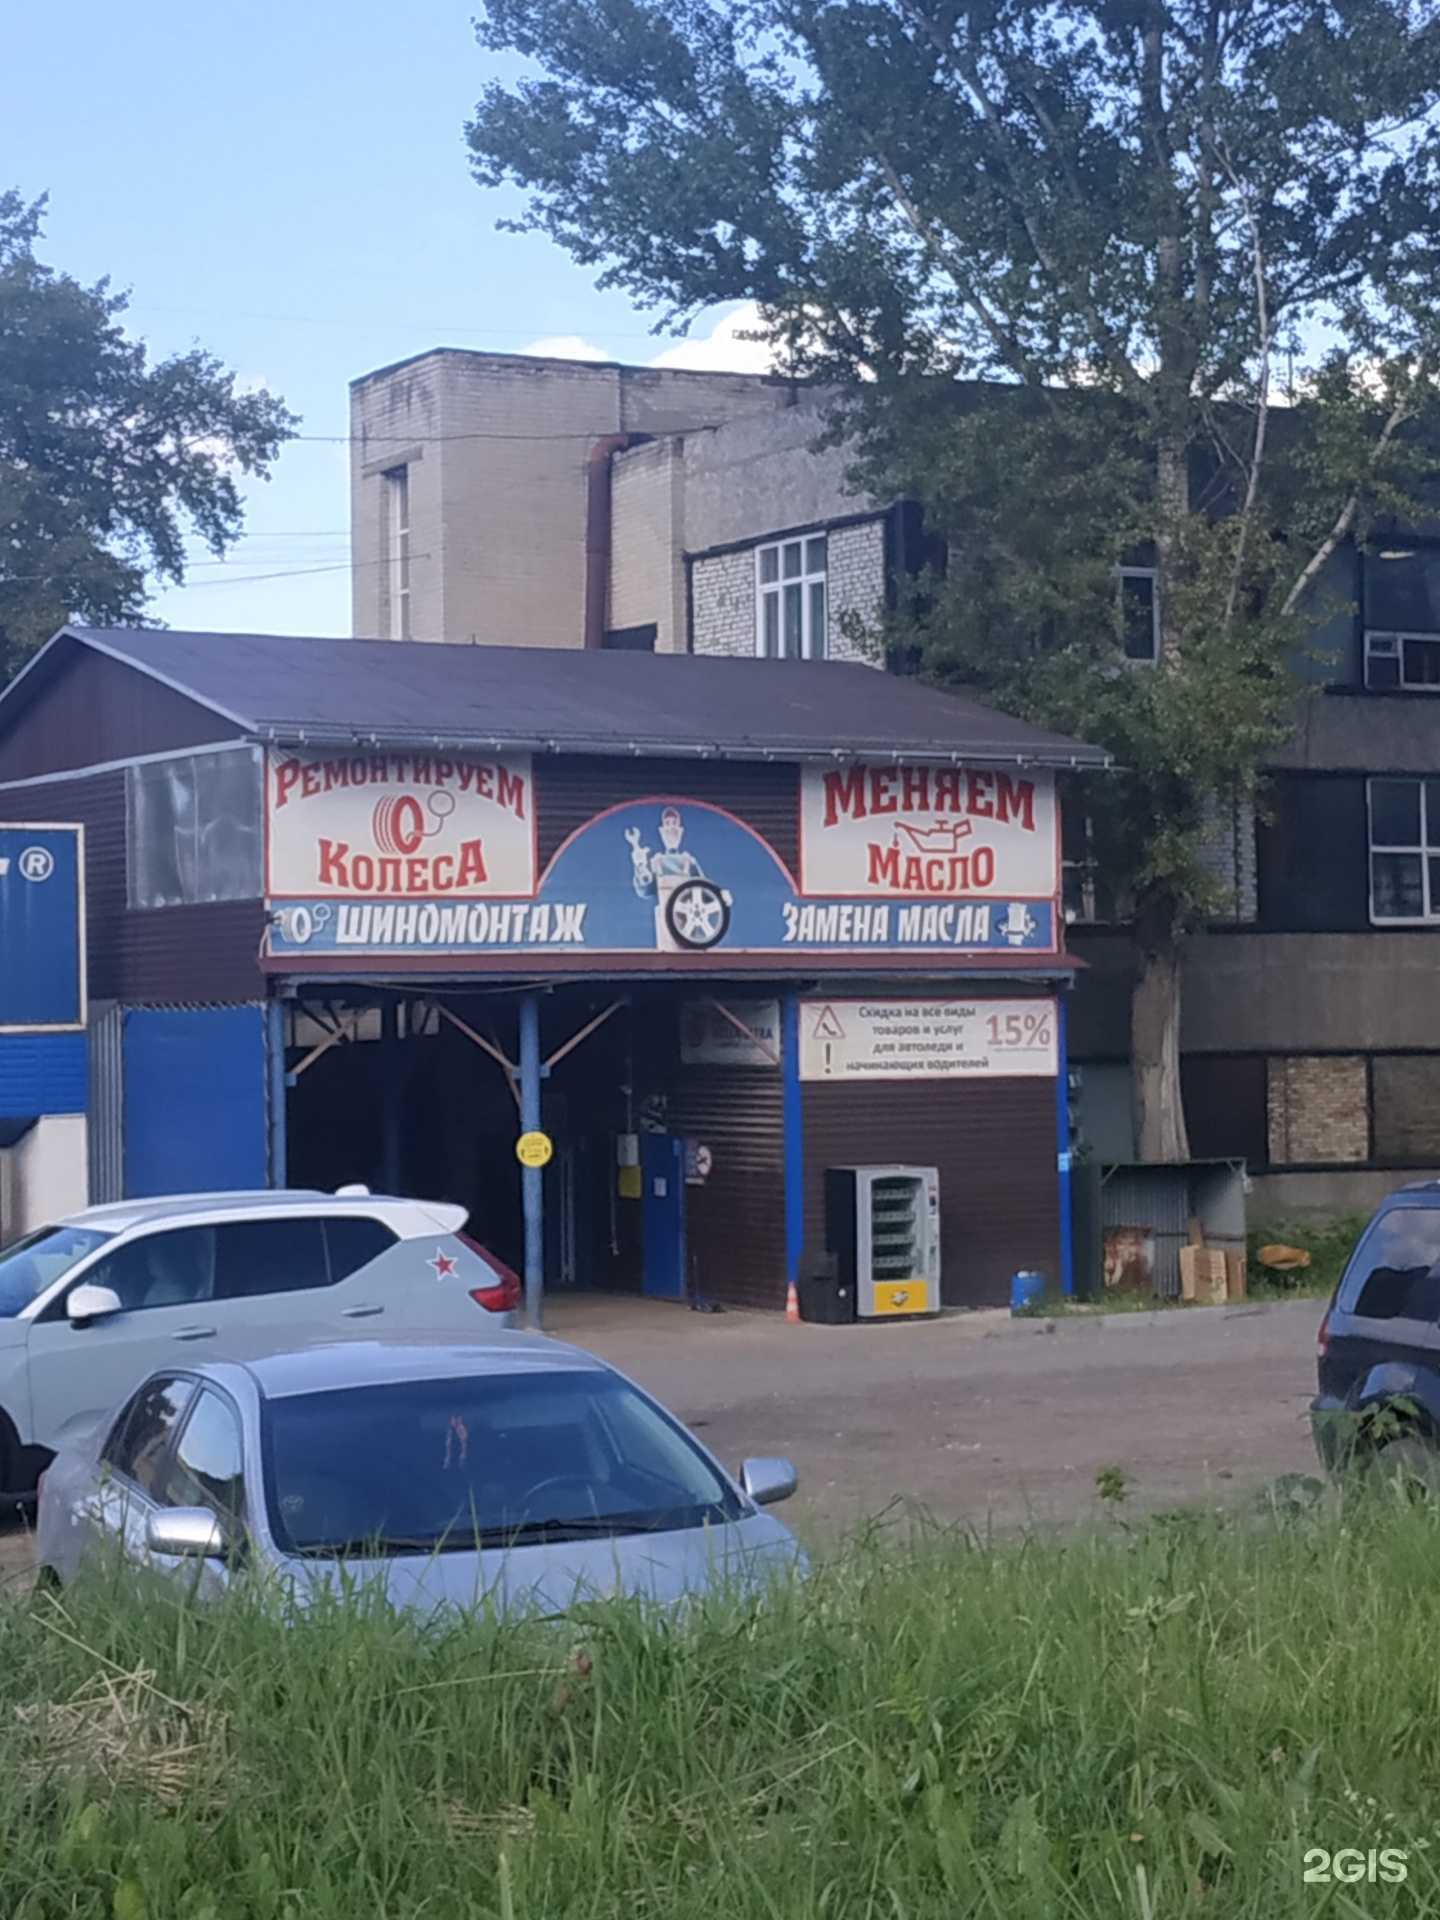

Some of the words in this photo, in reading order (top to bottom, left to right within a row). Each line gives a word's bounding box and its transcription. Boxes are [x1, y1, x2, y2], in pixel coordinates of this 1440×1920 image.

[275, 752, 525, 820] РЕМОНТИРУЕМ
[823, 764, 1036, 832] МЕНЯЕМ
[318, 838, 488, 893] КОЛЕСА
[867, 843, 995, 892] МАСЛО
[335, 903, 589, 945] ШИНОМОНТАЖ
[782, 903, 890, 943] ЗАМЕНА
[897, 904, 991, 943] МАСЛА
[858, 1006, 902, 1019] Скидка
[905, 1008, 919, 1018] на
[922, 1008, 941, 1018] все
[944, 1007, 976, 1019] виды
[872, 1025, 920, 1036] товаров
[933, 1024, 963, 1036] услуг
[985, 1013, 1050, 1046] 15%
[846, 1060, 924, 1072] начинающих
[927, 1057, 989, 1070] водителей
[872, 1043, 895, 1054] для
[899, 1042, 952, 1053] автоледи
